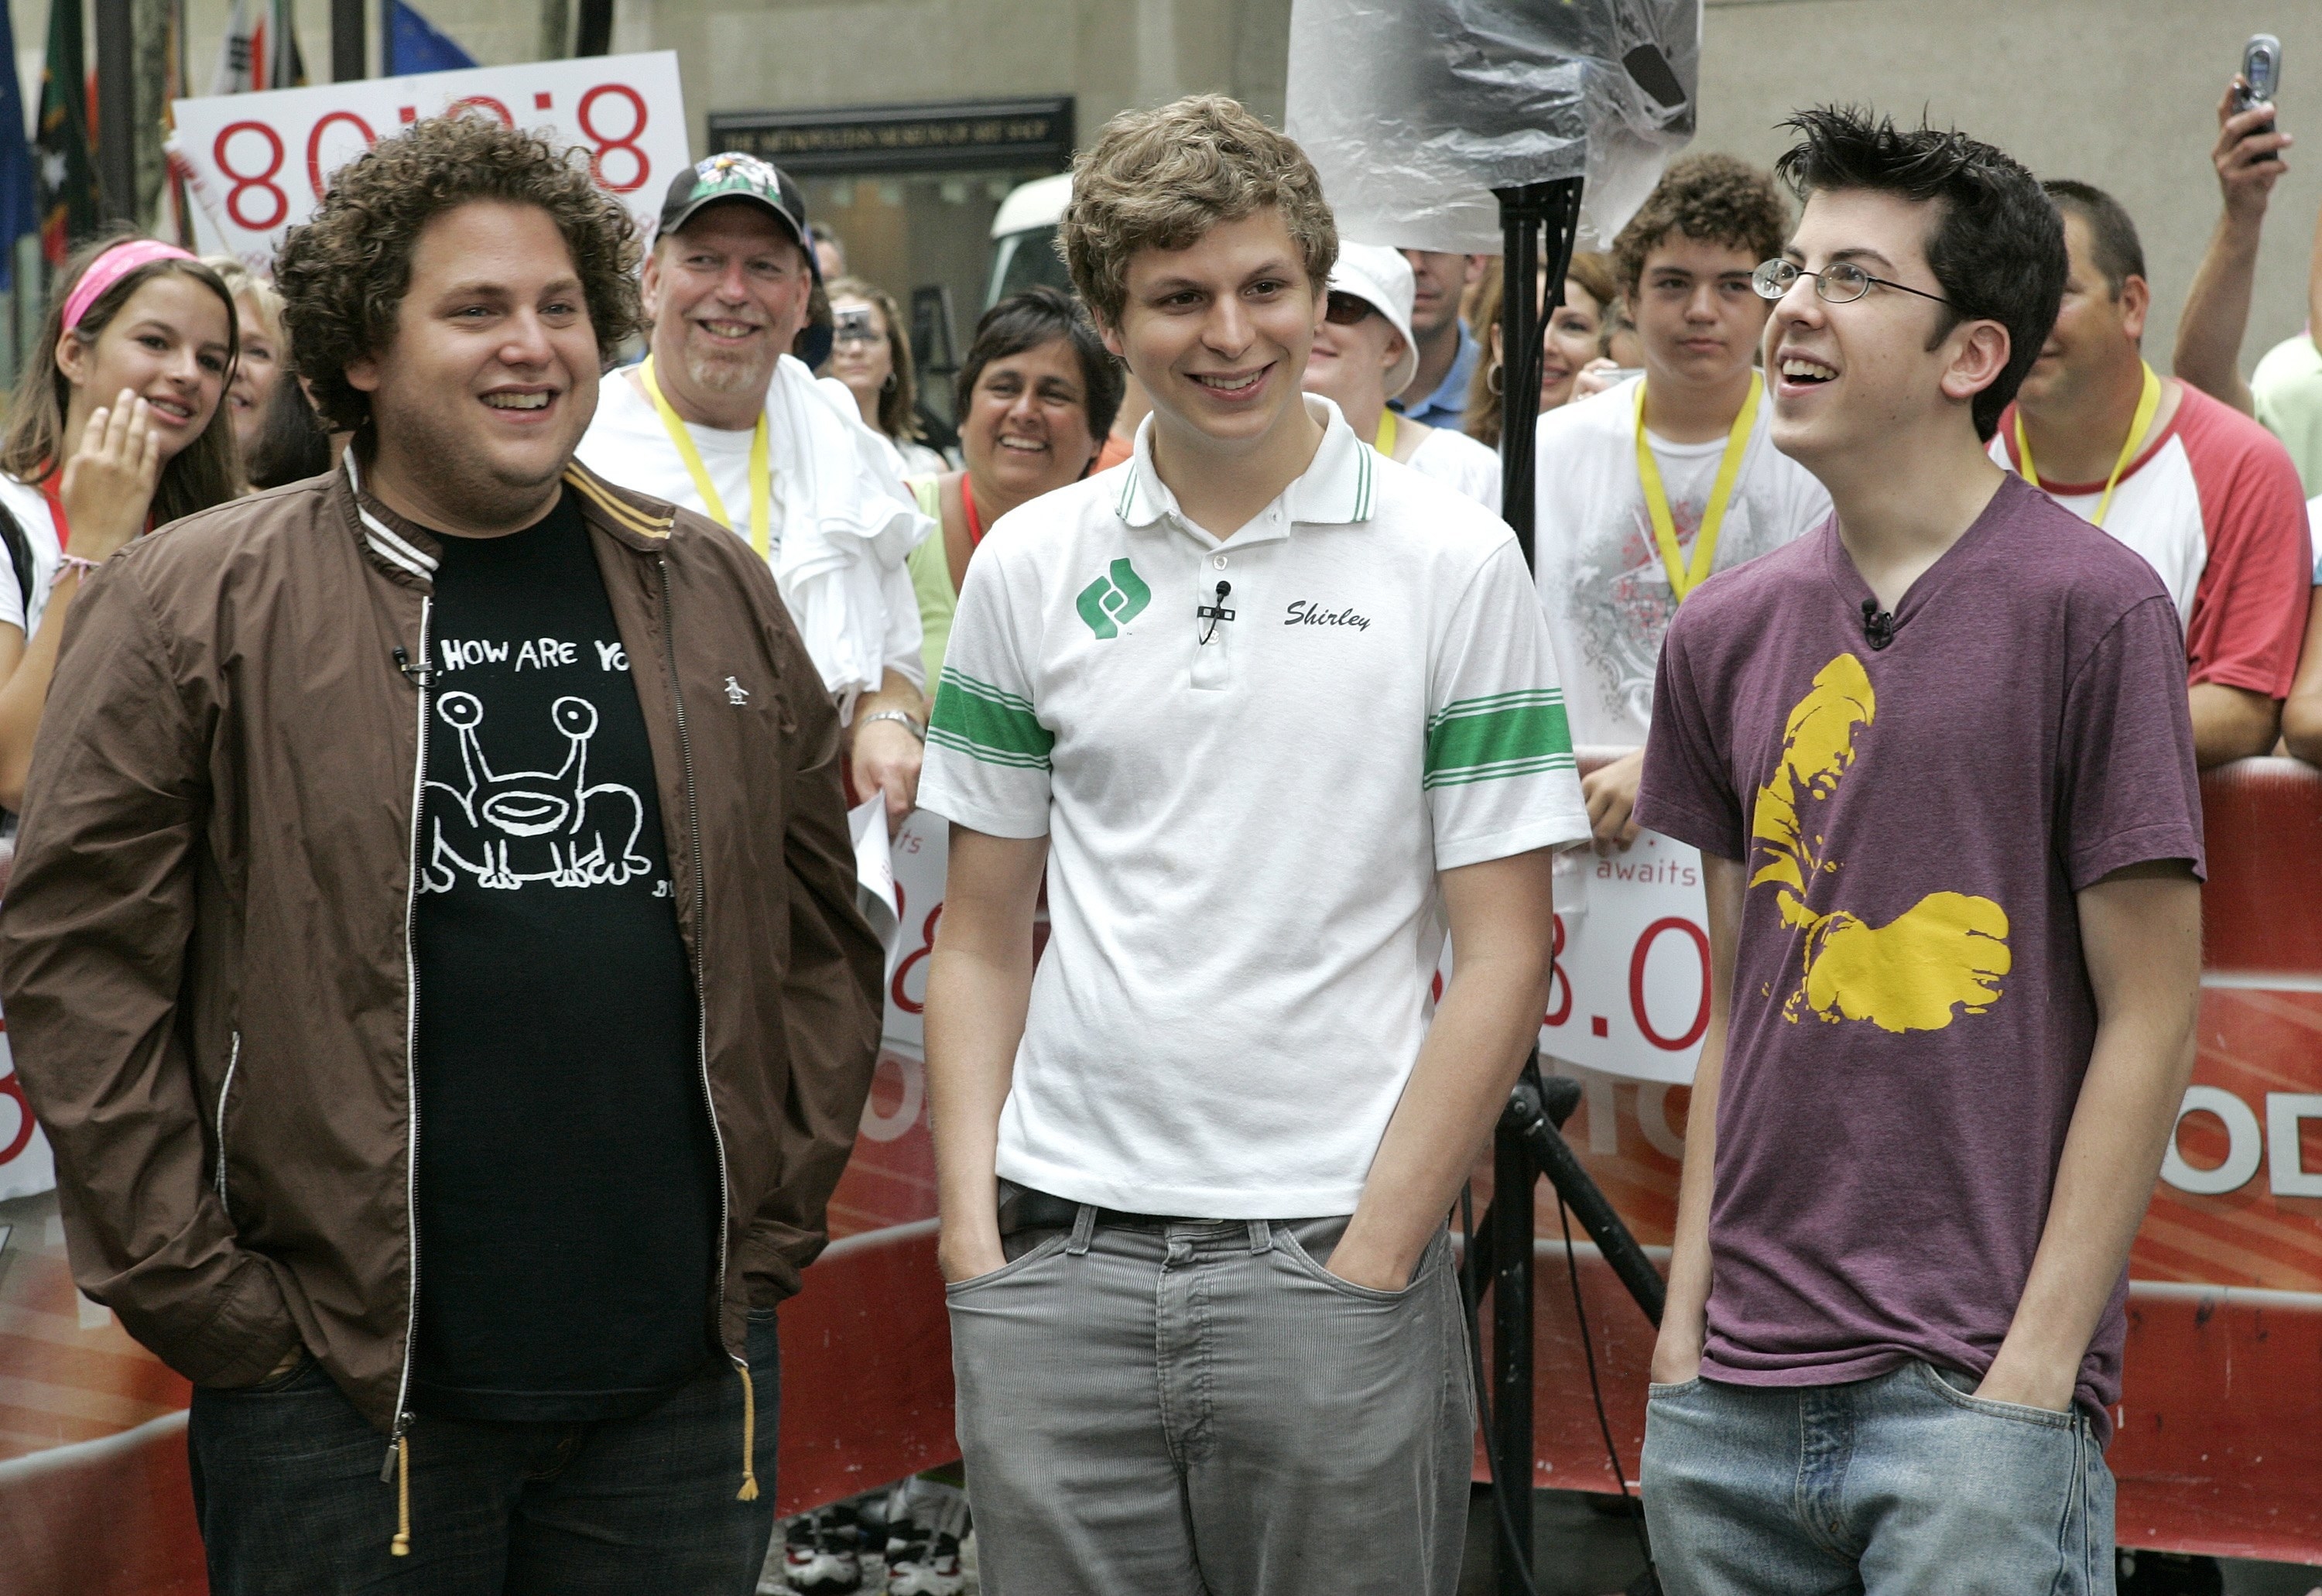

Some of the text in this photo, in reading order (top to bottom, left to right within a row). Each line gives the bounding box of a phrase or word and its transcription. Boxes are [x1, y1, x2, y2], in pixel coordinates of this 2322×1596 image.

[1284, 601, 1371, 632] Shirley
[440, 639, 509, 670] HOW
[515, 638, 578, 672] ARE
[1596, 858, 1697, 886] awaits
